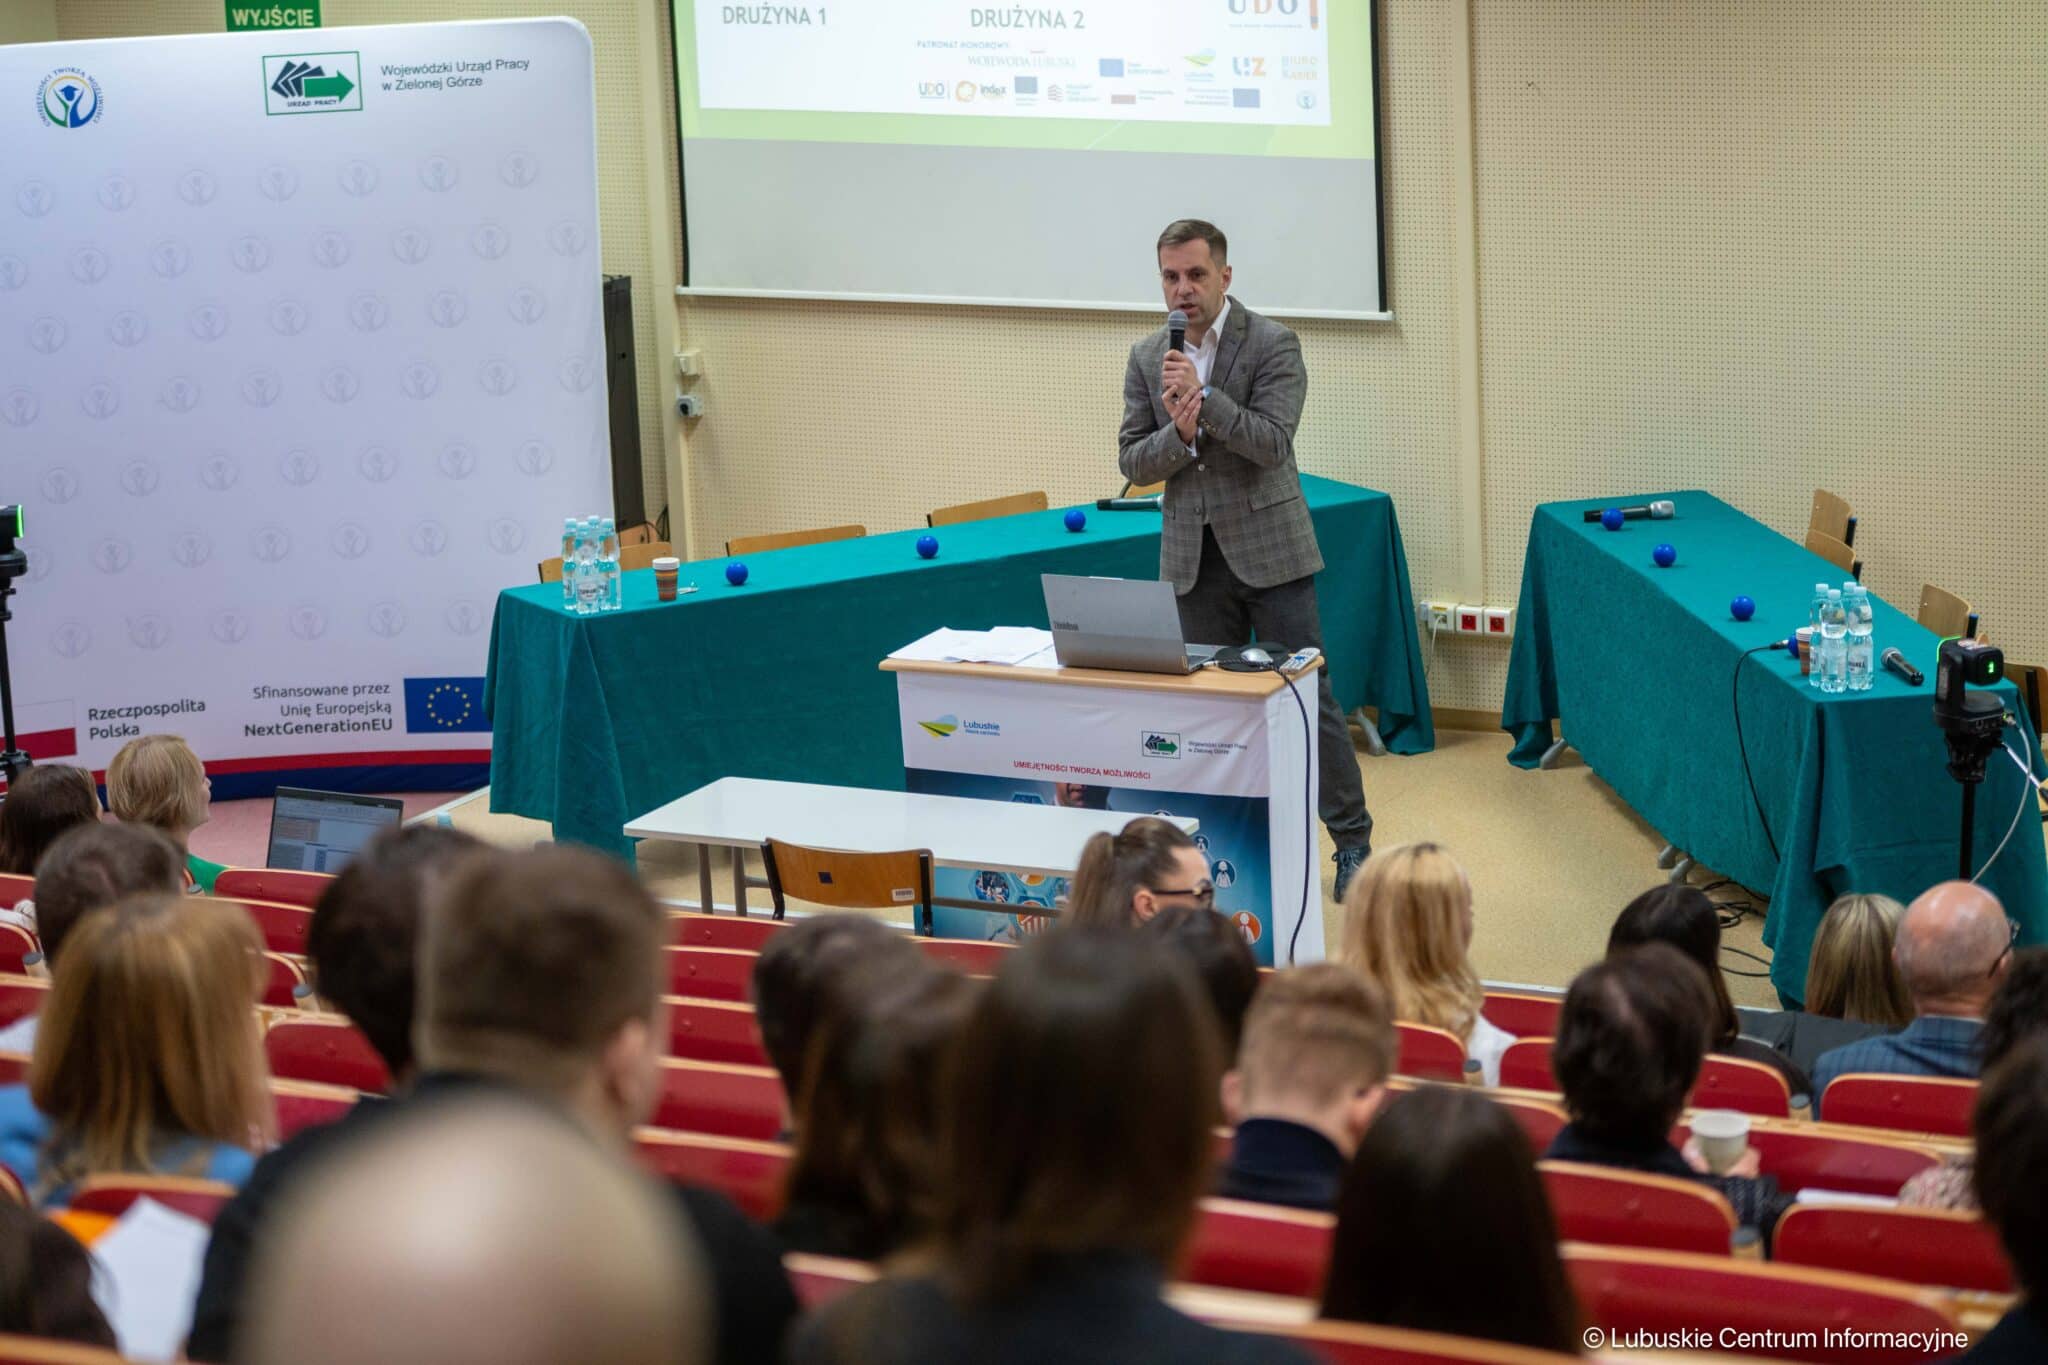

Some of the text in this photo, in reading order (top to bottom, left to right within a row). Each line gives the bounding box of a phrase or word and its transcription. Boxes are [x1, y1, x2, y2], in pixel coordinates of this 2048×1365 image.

[232, 4, 315, 27] WYJŚCIE
[722, 2, 827, 25] DRUŻYNA 1
[970, 5, 1085, 29] DRUŻYNA 2
[381, 58, 530, 78] Wojewódzki Urząd Pracy
[382, 76, 483, 91] w Zielonej Górze
[253, 684, 391, 700] Sfinansowane przez
[88, 699, 206, 721] Rzeczpospolita
[281, 701, 393, 718] Unię Europejską
[89, 724, 140, 740] Polska
[244, 718, 393, 737] NextGenerationEU
[1013, 760, 1151, 779] UMIEJĘTNOŚCI TWORZĄ MOŻLIWOŚCI
